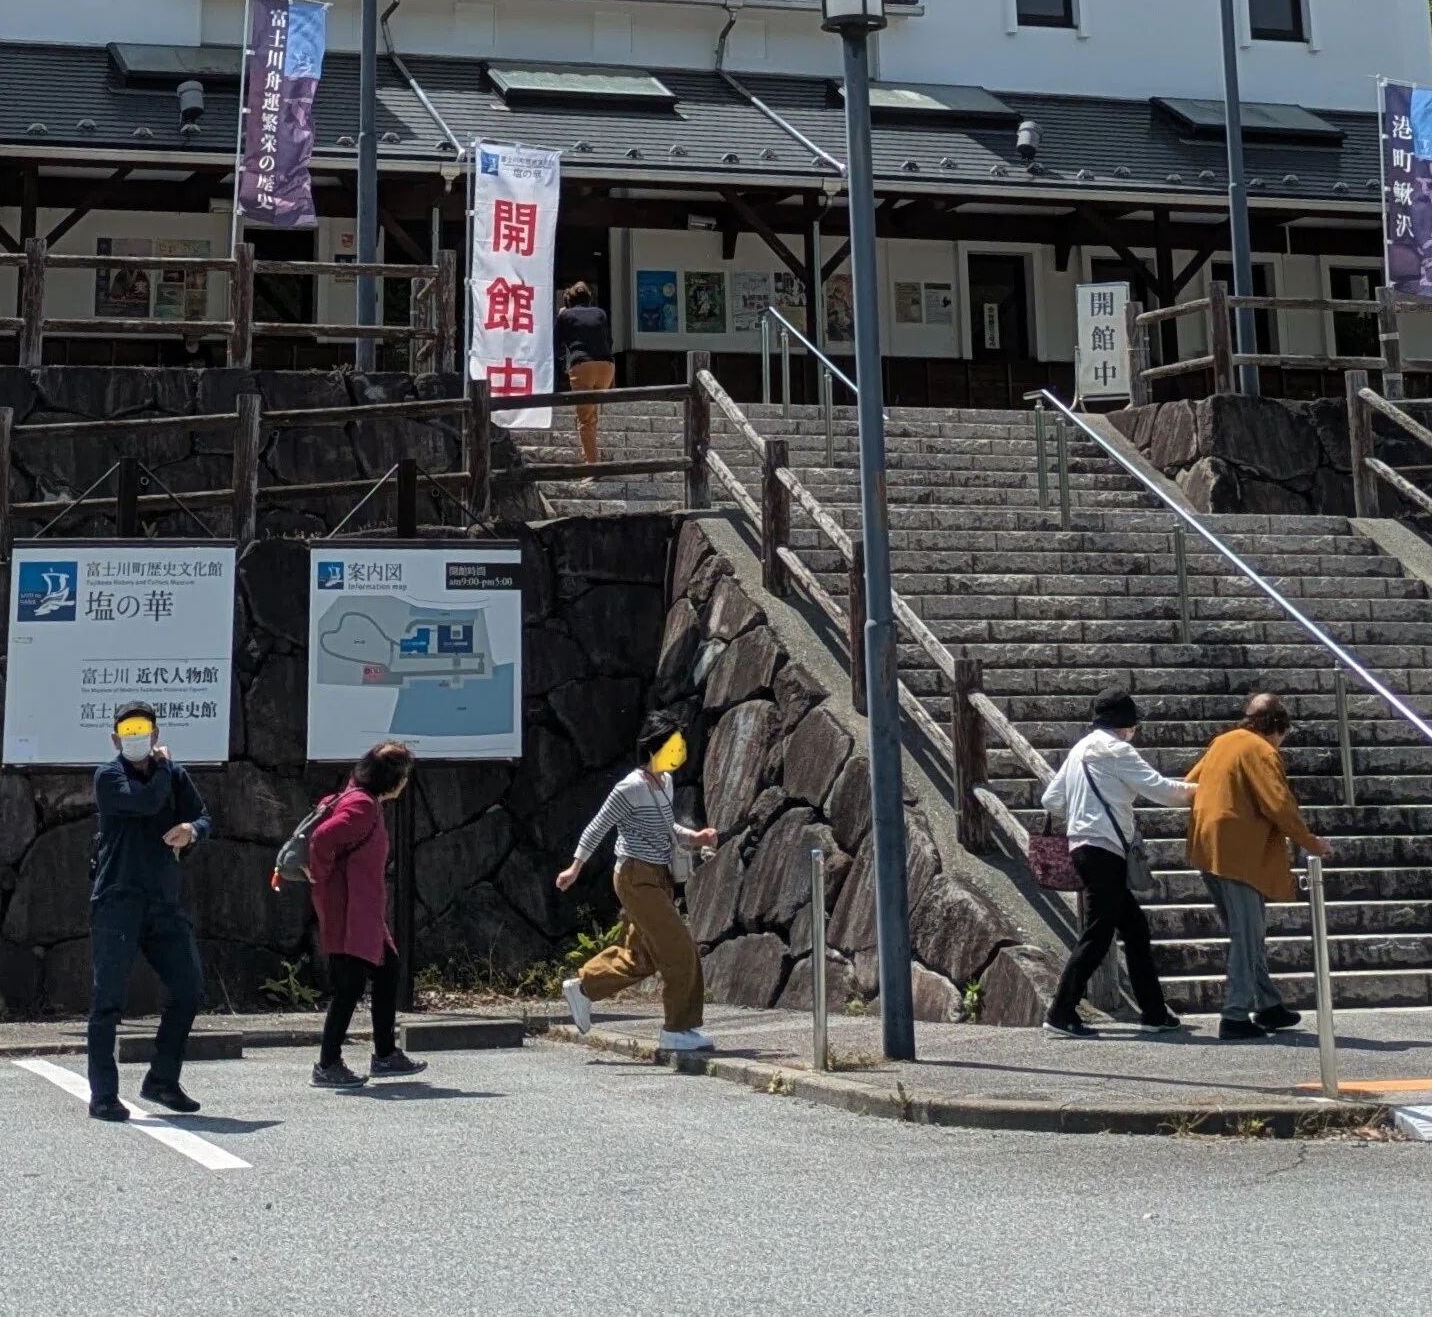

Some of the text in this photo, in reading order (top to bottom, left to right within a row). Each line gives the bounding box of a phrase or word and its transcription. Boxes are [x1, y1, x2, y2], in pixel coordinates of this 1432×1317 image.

[256, 8, 288, 210] 富士川舟運繁栄の歴史
[1392, 115, 1415, 238] 港町鰍沢
[484, 199, 538, 397] 開館中
[1090, 291, 1117, 387] 開館中
[85, 560, 224, 578] 富士川町歴史文化館
[347, 562, 403, 582] 案内図
[85, 589, 173, 622] 塩の華
[81, 667, 220, 685] 富士川 近代人物館
[153, 701, 218, 719] 運歴史館
